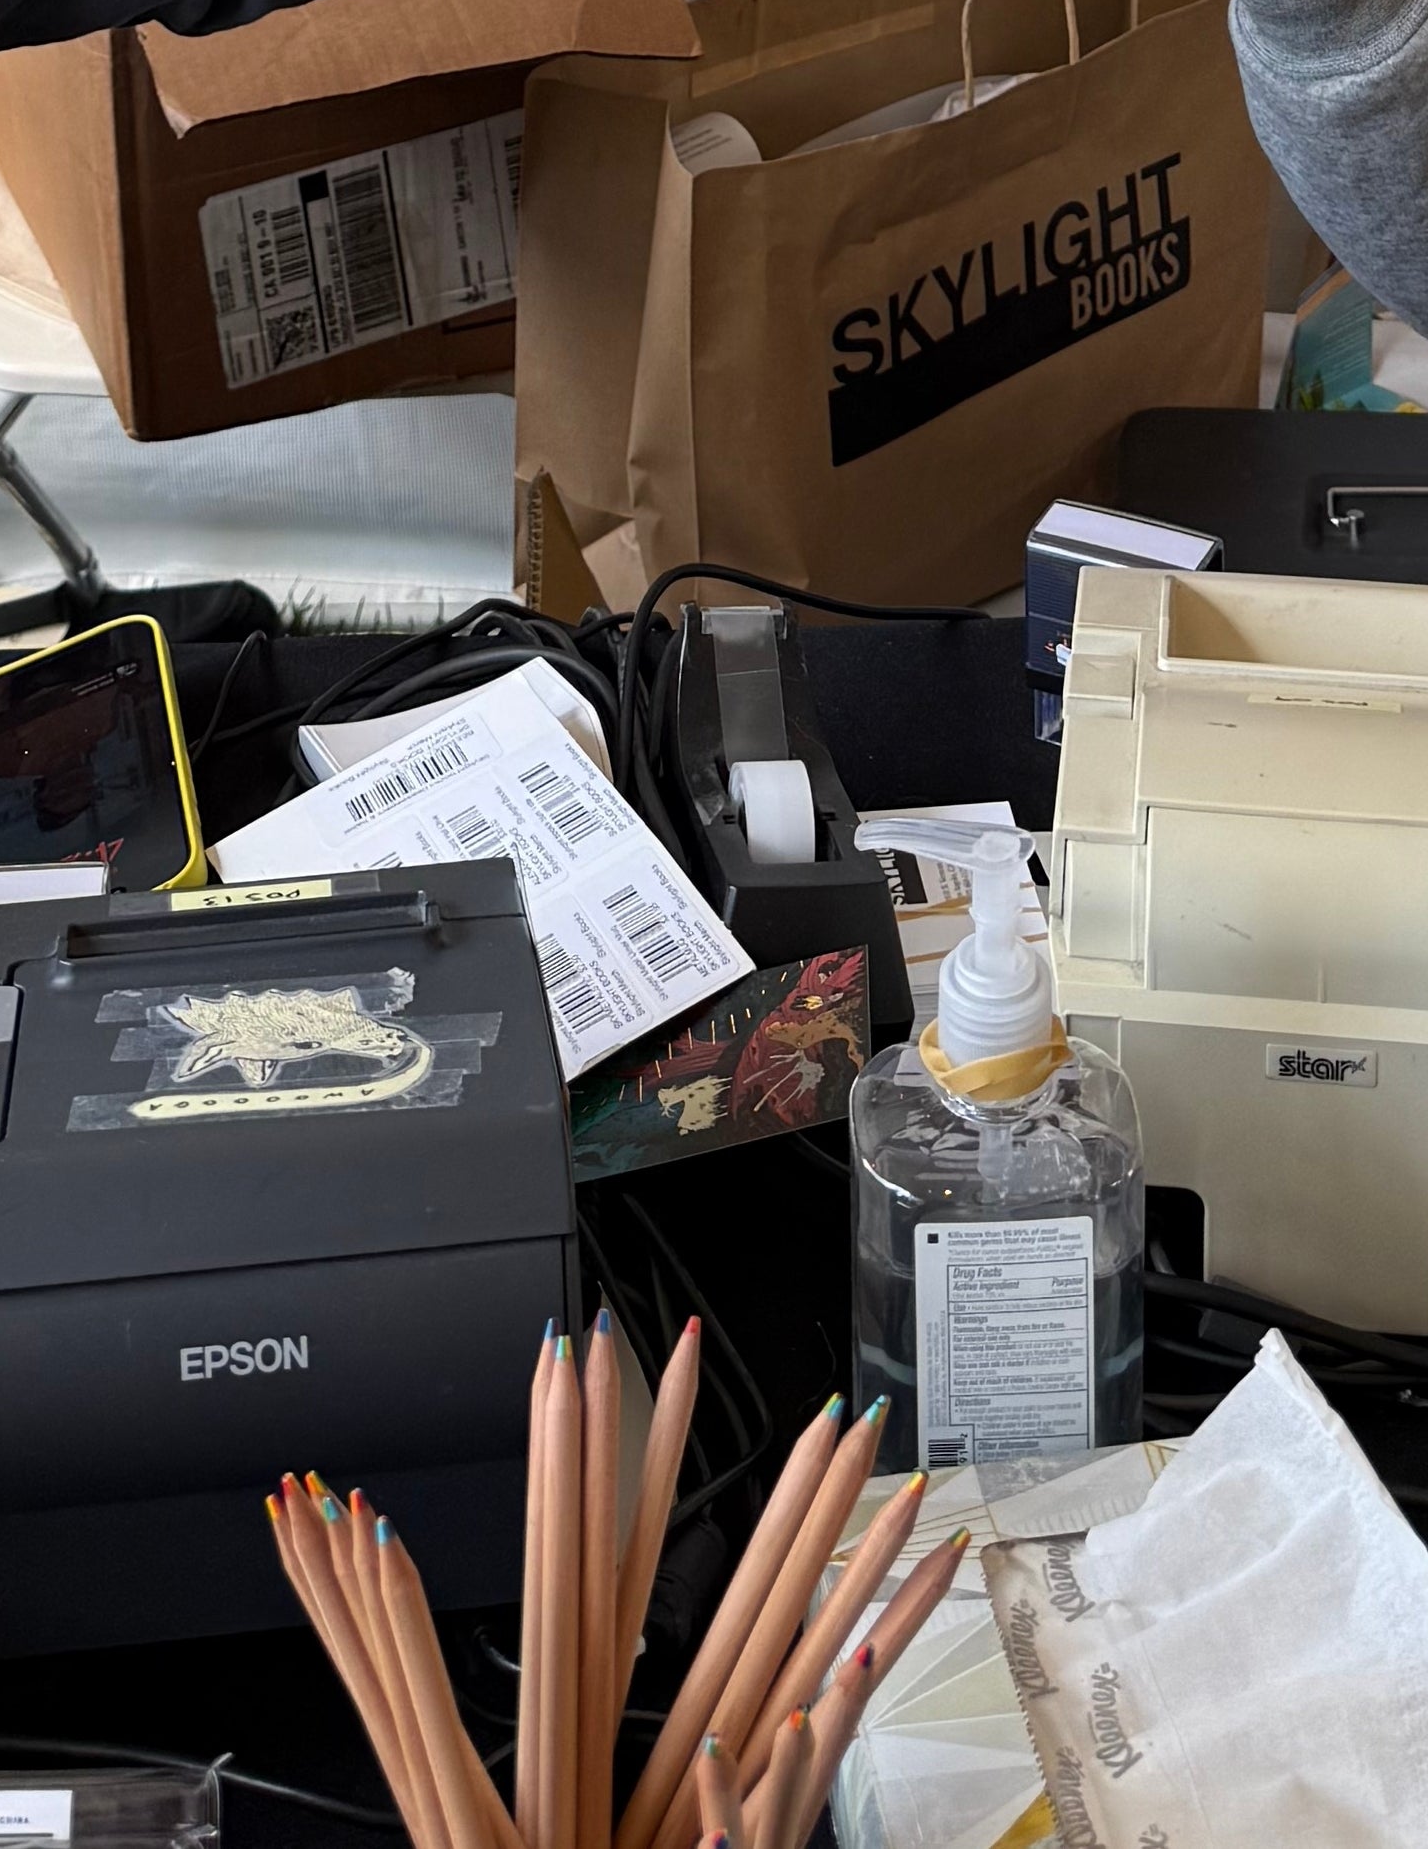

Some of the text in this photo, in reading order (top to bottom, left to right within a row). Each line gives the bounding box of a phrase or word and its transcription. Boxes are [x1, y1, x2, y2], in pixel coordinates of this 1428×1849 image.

[830, 152, 1183, 387] SKYLIGHT
[1070, 231, 1183, 331] BOOKS
[244, 888, 300, 901] POS
[1278, 1049, 1351, 1083] star
[953, 1267, 1003, 1280] Drug Facts
[180, 1335, 309, 1382] EPSON
[1009, 1602, 1060, 1700] Kleenex
[1087, 1669, 1144, 1779] Kleenex
